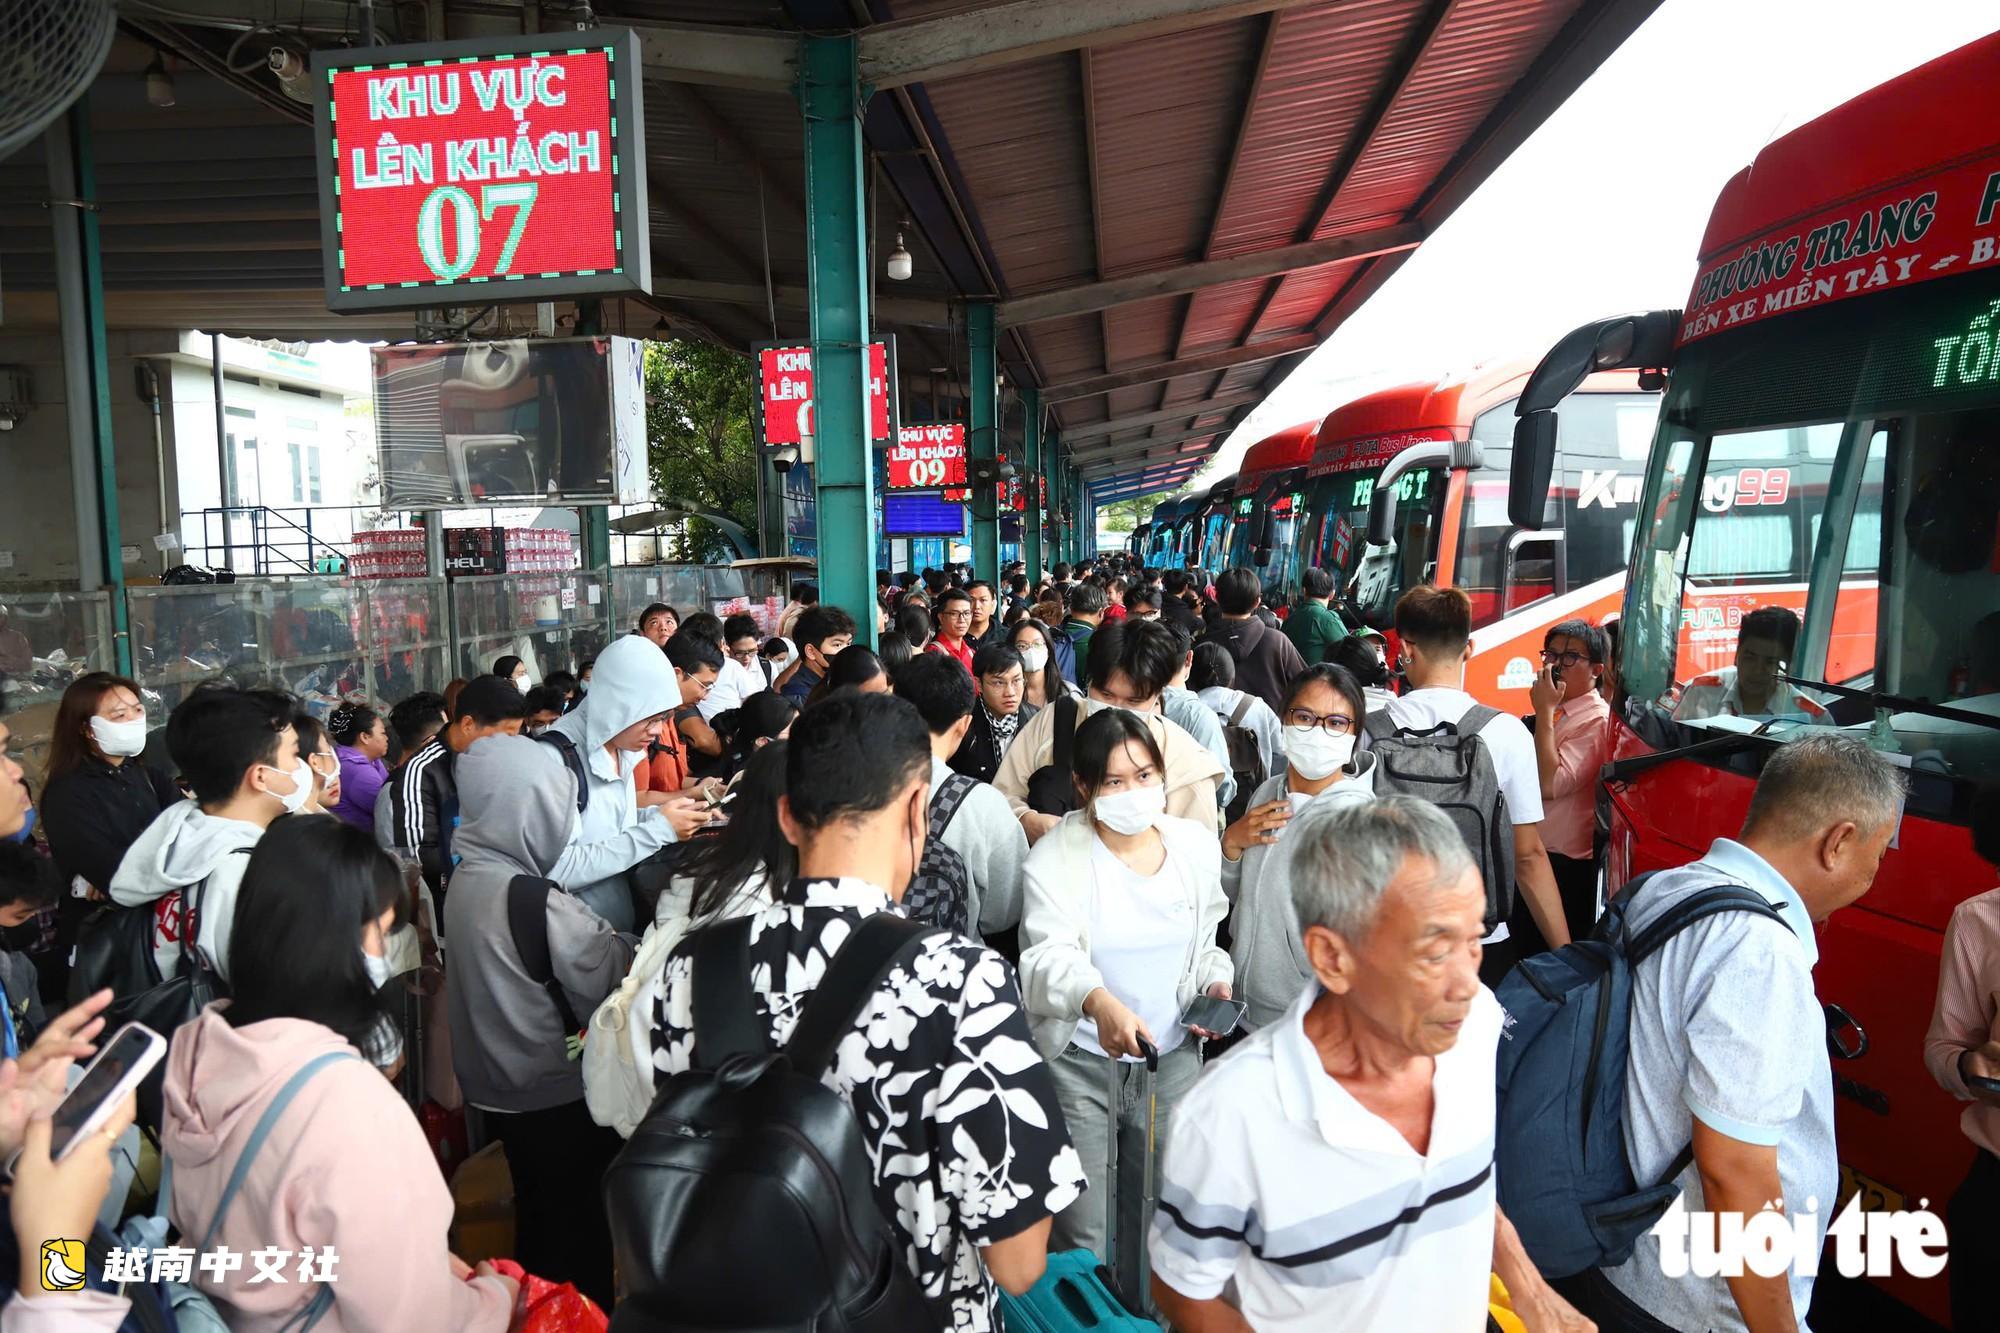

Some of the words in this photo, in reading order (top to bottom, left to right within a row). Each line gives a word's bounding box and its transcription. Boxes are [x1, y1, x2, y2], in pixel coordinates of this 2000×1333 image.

[367, 71, 461, 121] KHU
[469, 60, 566, 121] VỰC
[351, 131, 434, 189] LÊN
[445, 121, 601, 182] KHÁCH
[417, 182, 538, 280] 07
[1692, 236, 1800, 313] PHƯƠNG
[1802, 191, 1938, 272] TRANG
[1681, 305, 1719, 342] BẾN
[1724, 298, 1758, 326] XE
[1761, 270, 1835, 315] MIỀN
[1845, 254, 1922, 293] TÂY
[1968, 235, 2000, 265] B
[770, 376, 808, 401] LÊN
[899, 429, 924, 442] KHU
[1380, 437, 1400, 453] Bus
[892, 444, 917, 461] LÊN
[1367, 458, 1380, 468] XE
[909, 458, 946, 486] 09
[446, 557, 484, 569] HELI
[1680, 606, 1726, 630] FUTA
